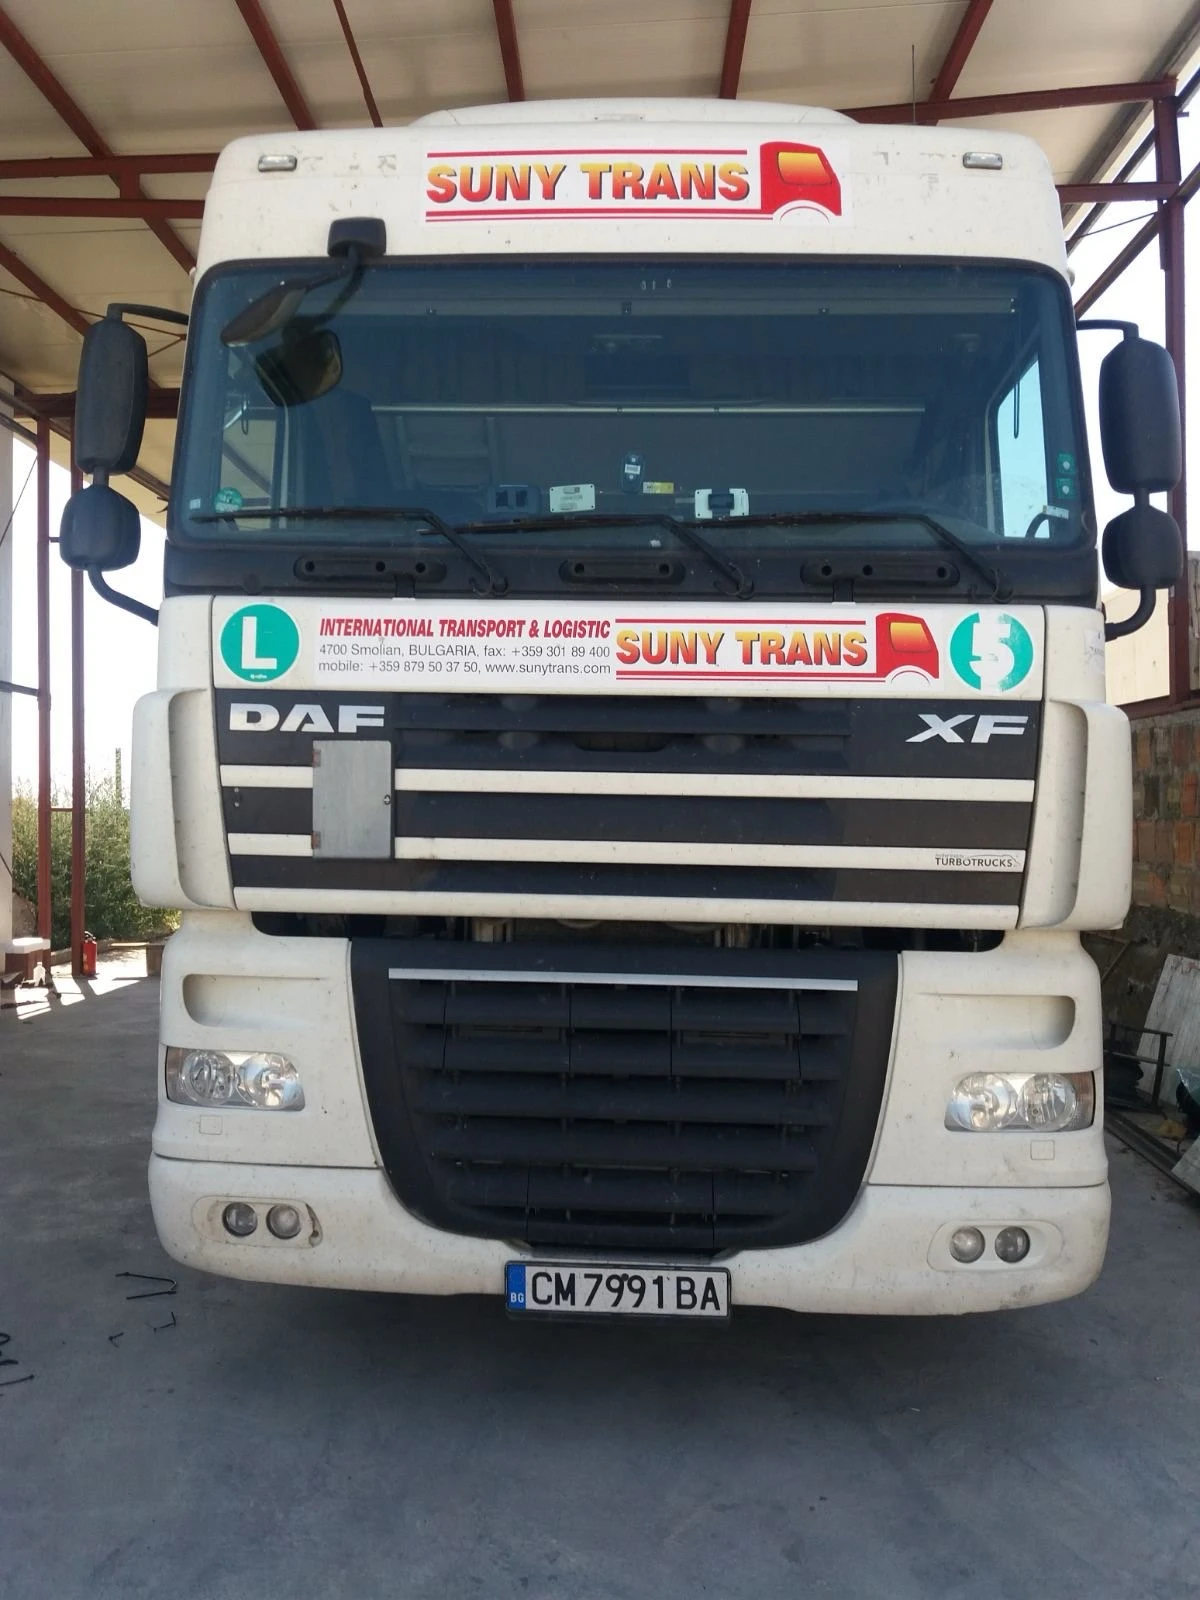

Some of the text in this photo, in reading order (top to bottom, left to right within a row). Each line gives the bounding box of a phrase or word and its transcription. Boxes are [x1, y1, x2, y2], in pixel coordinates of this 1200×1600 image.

[426, 162, 750, 203] SUNY TRANS
[319, 618, 611, 639] INTERNATIONAL TRANSPORT & LOGISTIC
[241, 615, 277, 669] L
[319, 643, 611, 658] 4700 Smolian, BULGARIA, fax: +359 301 89 400
[616, 627, 868, 667] SUNY TRANS
[318, 660, 611, 676] mobile: +359 879 50 37 50, www.sunytrans.com
[229, 703, 385, 733] DAF
[904, 714, 1029, 744] XF
[935, 857, 1013, 868] TURBOTRUCKS
[510, 1291, 525, 1303] BG
